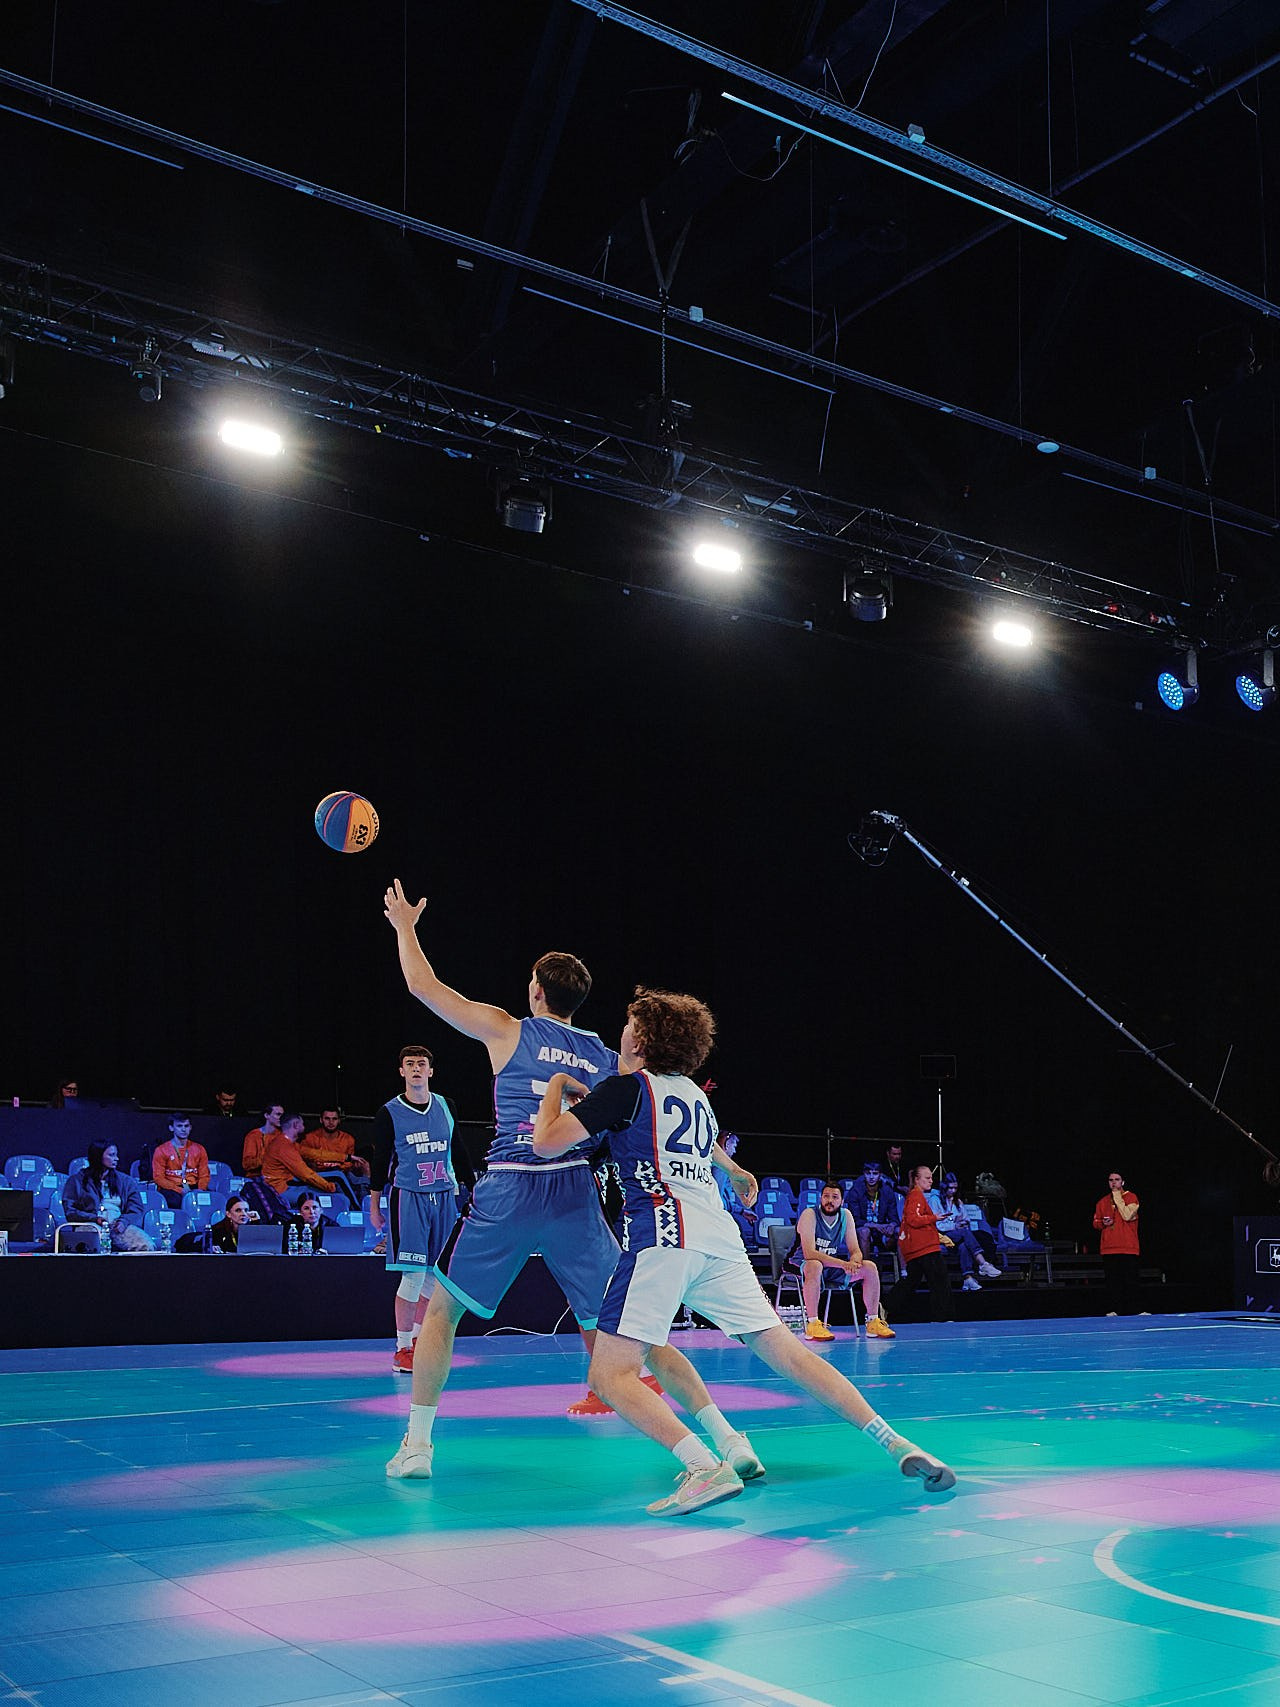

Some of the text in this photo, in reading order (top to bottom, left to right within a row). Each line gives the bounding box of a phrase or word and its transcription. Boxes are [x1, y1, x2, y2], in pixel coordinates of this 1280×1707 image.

[664, 1095, 713, 1159] 20
[416, 1140, 447, 1154] ИГРЫ
[417, 1160, 449, 1187] 34
